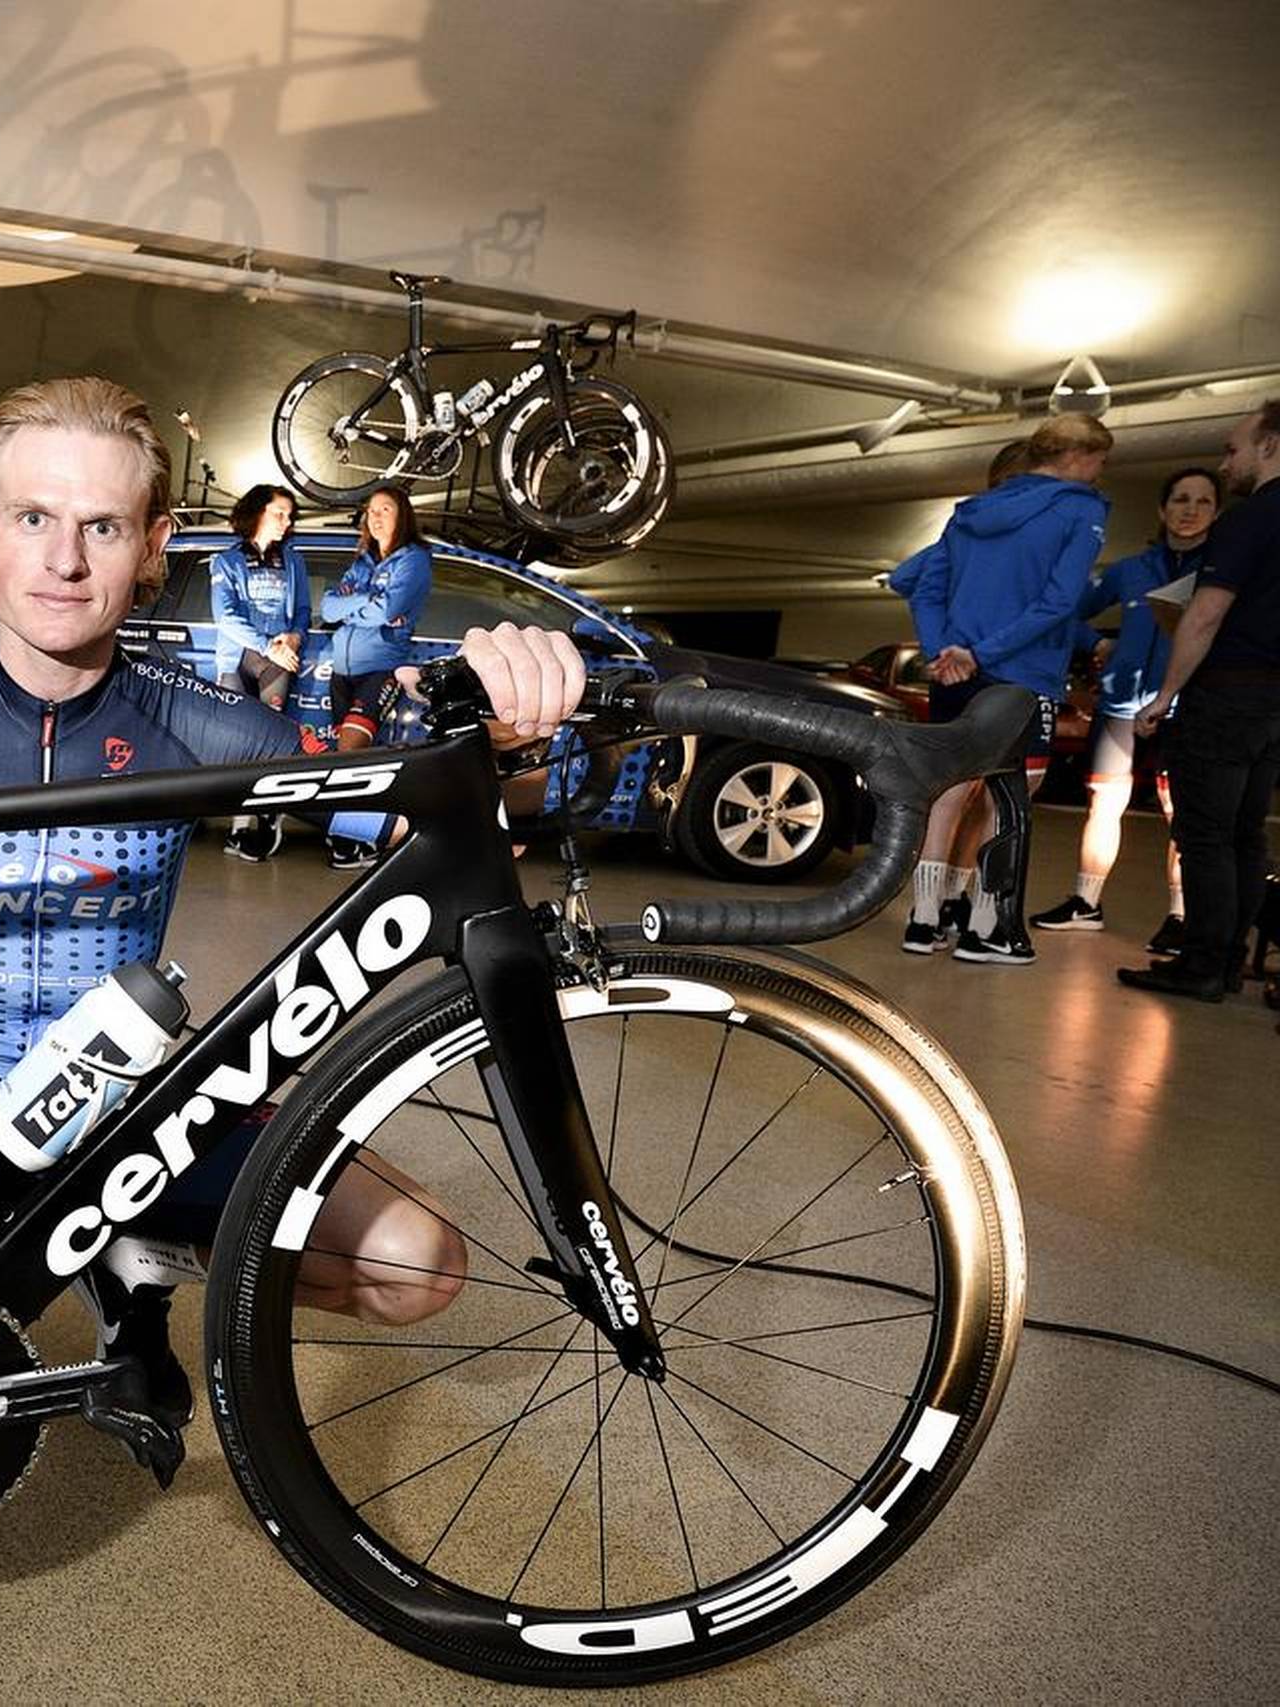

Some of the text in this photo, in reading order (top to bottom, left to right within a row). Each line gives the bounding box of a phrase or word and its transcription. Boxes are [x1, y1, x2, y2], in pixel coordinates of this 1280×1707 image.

[242, 761, 404, 807] S5
[46, 894, 432, 1277] cervélo
[582, 1201, 640, 1327] cervélo
